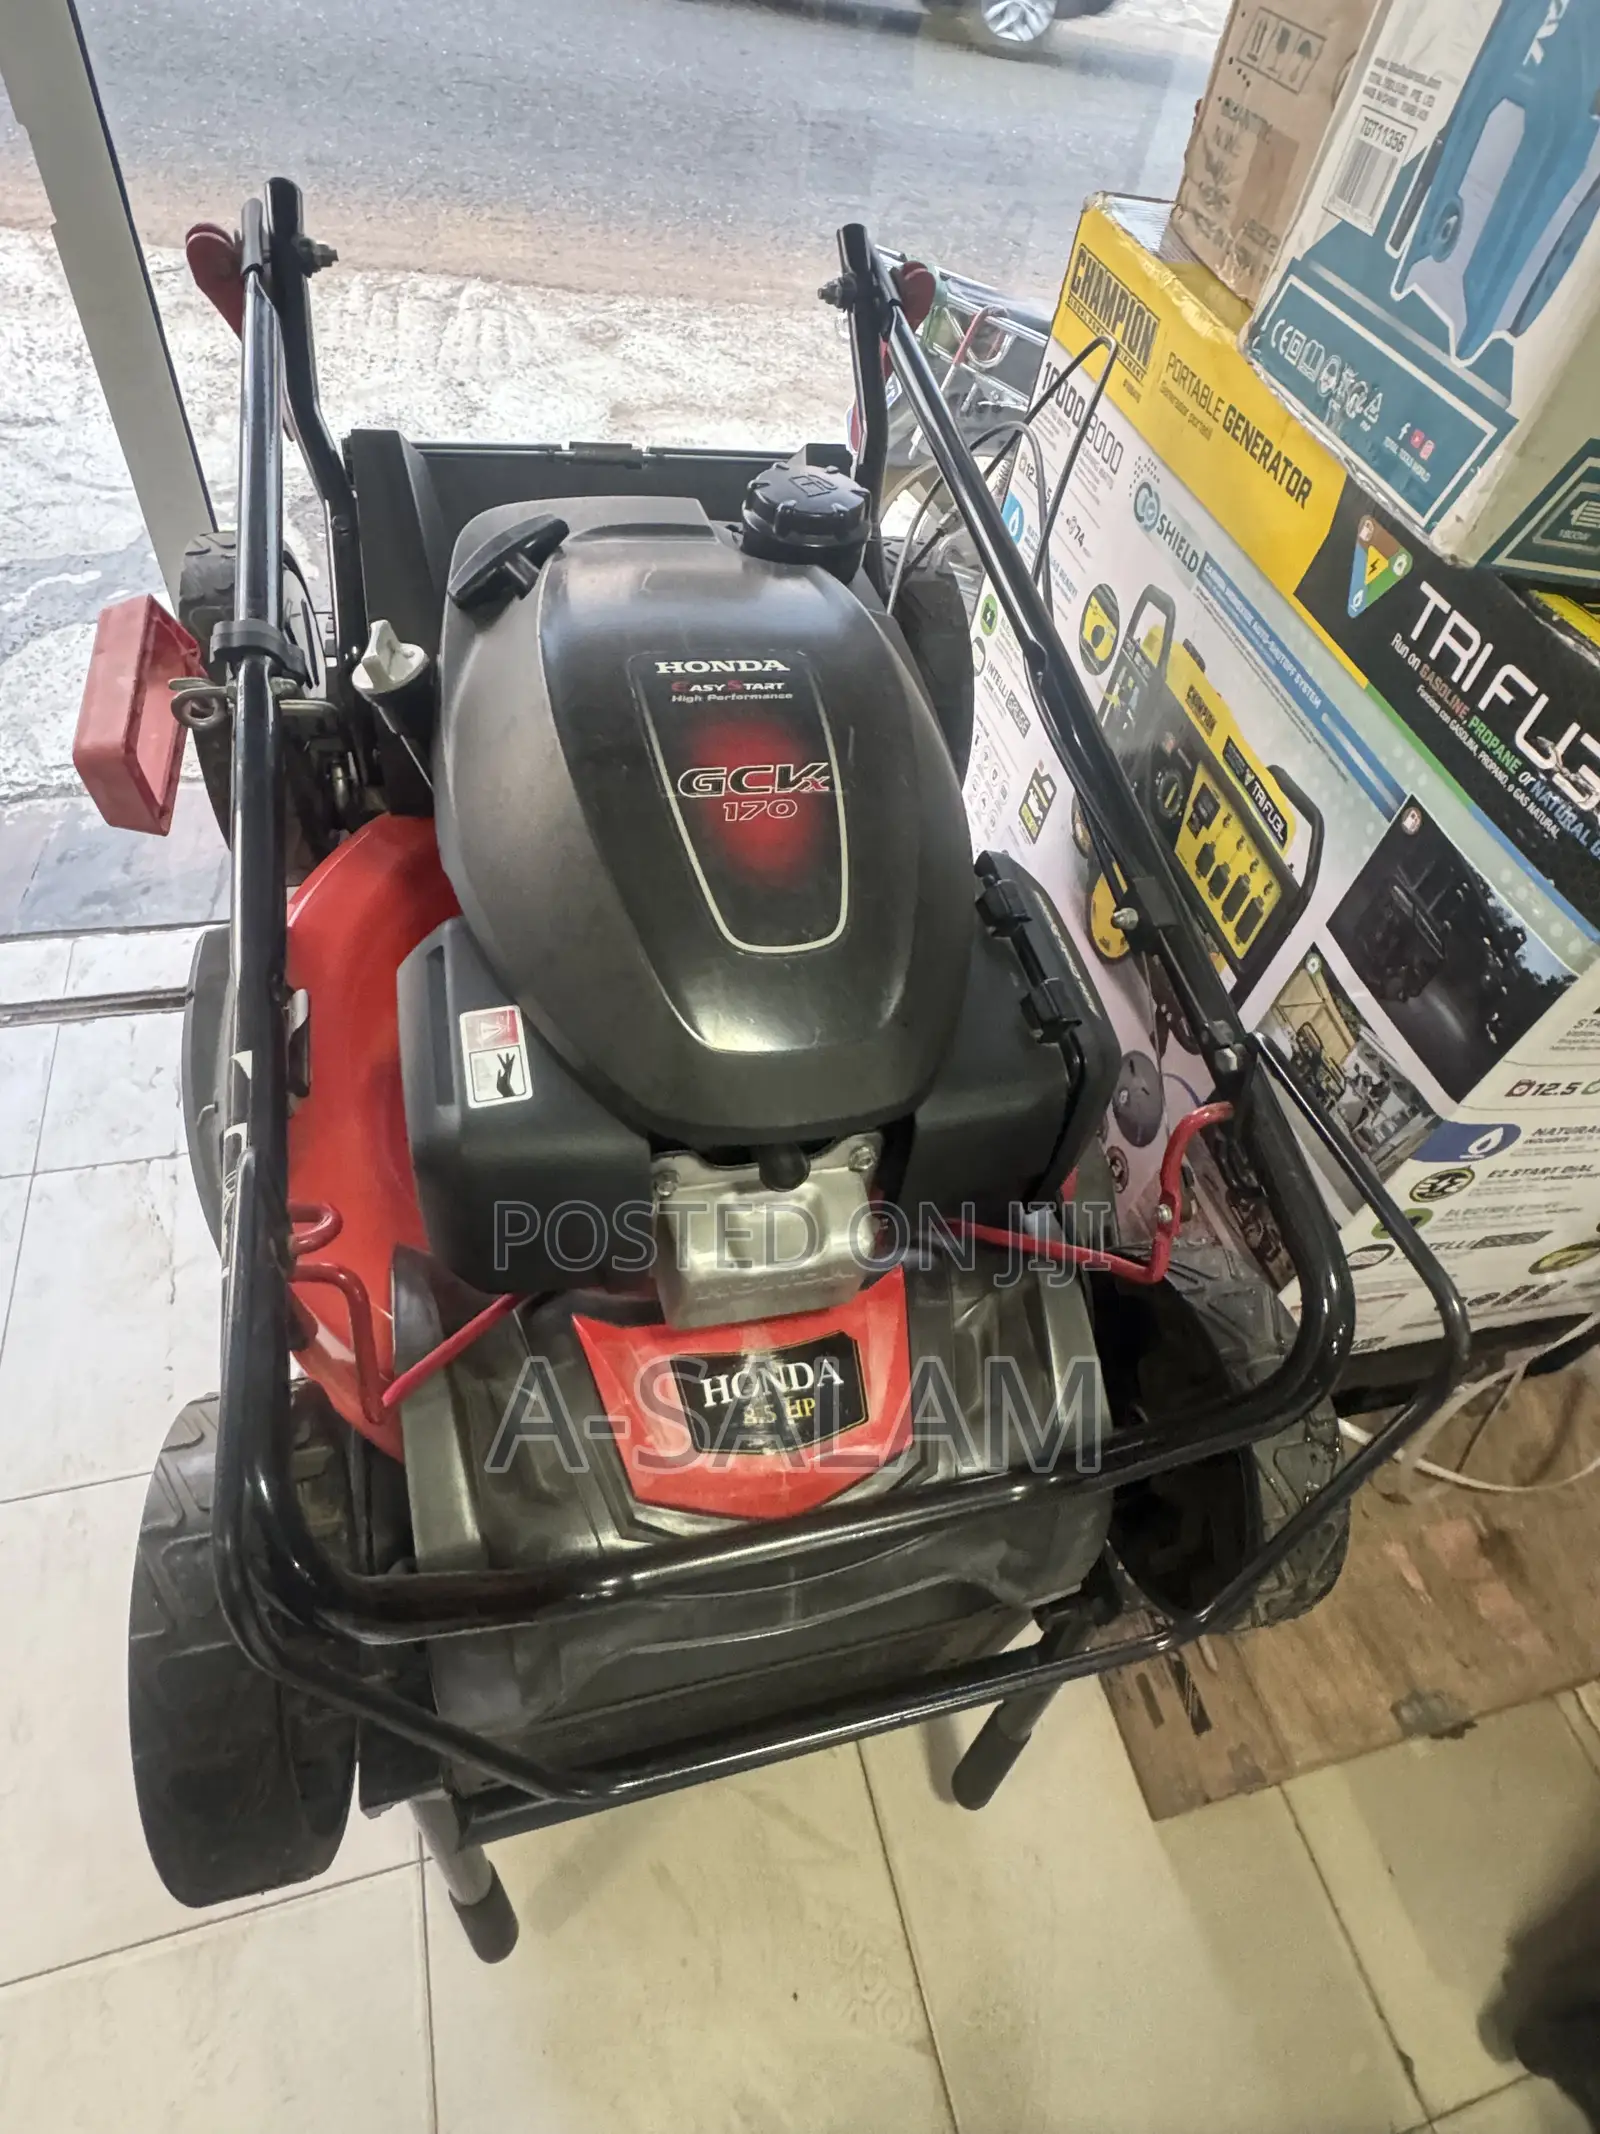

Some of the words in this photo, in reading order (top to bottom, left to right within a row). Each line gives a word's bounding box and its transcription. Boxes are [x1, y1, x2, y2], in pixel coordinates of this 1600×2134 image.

[1359, 116, 1408, 153] TGT11356
[1071, 247, 1158, 371] CHAMPION
[1086, 411, 1124, 475] 8000
[1165, 351, 1226, 424] PORTABLE
[1222, 403, 1313, 510] GENERATOR
[1411, 460, 1431, 483] WORLD
[1073, 524, 1085, 548] 74
[1156, 513, 1200, 573] SHIELD
[1410, 580, 1494, 693] TRI
[655, 660, 791, 674] HONDA
[986, 659, 1009, 699] INTELLI
[1251, 618, 1296, 677] AUTO-SHUTOFF
[1293, 671, 1322, 709] SYSTEM
[671, 681, 727, 692] EASY
[727, 680, 786, 691] START
[671, 694, 702, 704] High
[707, 691, 794, 702] Performance
[1391, 632, 1410, 659] Run
[1407, 653, 1421, 672] on
[1418, 663, 1471, 726] GASOLINE,
[1467, 714, 1523, 774] PROPANE
[1518, 770, 1537, 787] or
[1529, 780, 1592, 848] NATURAL
[1590, 837, 1600, 860] G
[1416, 684, 1441, 714] Funciona
[1439, 709, 1452, 724] con
[1448, 718, 1480, 757] GASOLINA,
[1477, 749, 1508, 789] PROPANO,
[1512, 787, 1531, 808] GAS
[1526, 803, 1561, 840] NATURAL
[722, 800, 798, 822] 170
[1531, 1082, 1583, 1097] 12.5
[1532, 1125, 1600, 1137] NATURA
[1510, 1166, 1560, 1178] START
[1561, 1164, 1595, 1174] DIAL
[701, 1358, 845, 1408] HONDA
[743, 1403, 778, 1426] 8.5
[785, 1397, 817, 1420] HP
